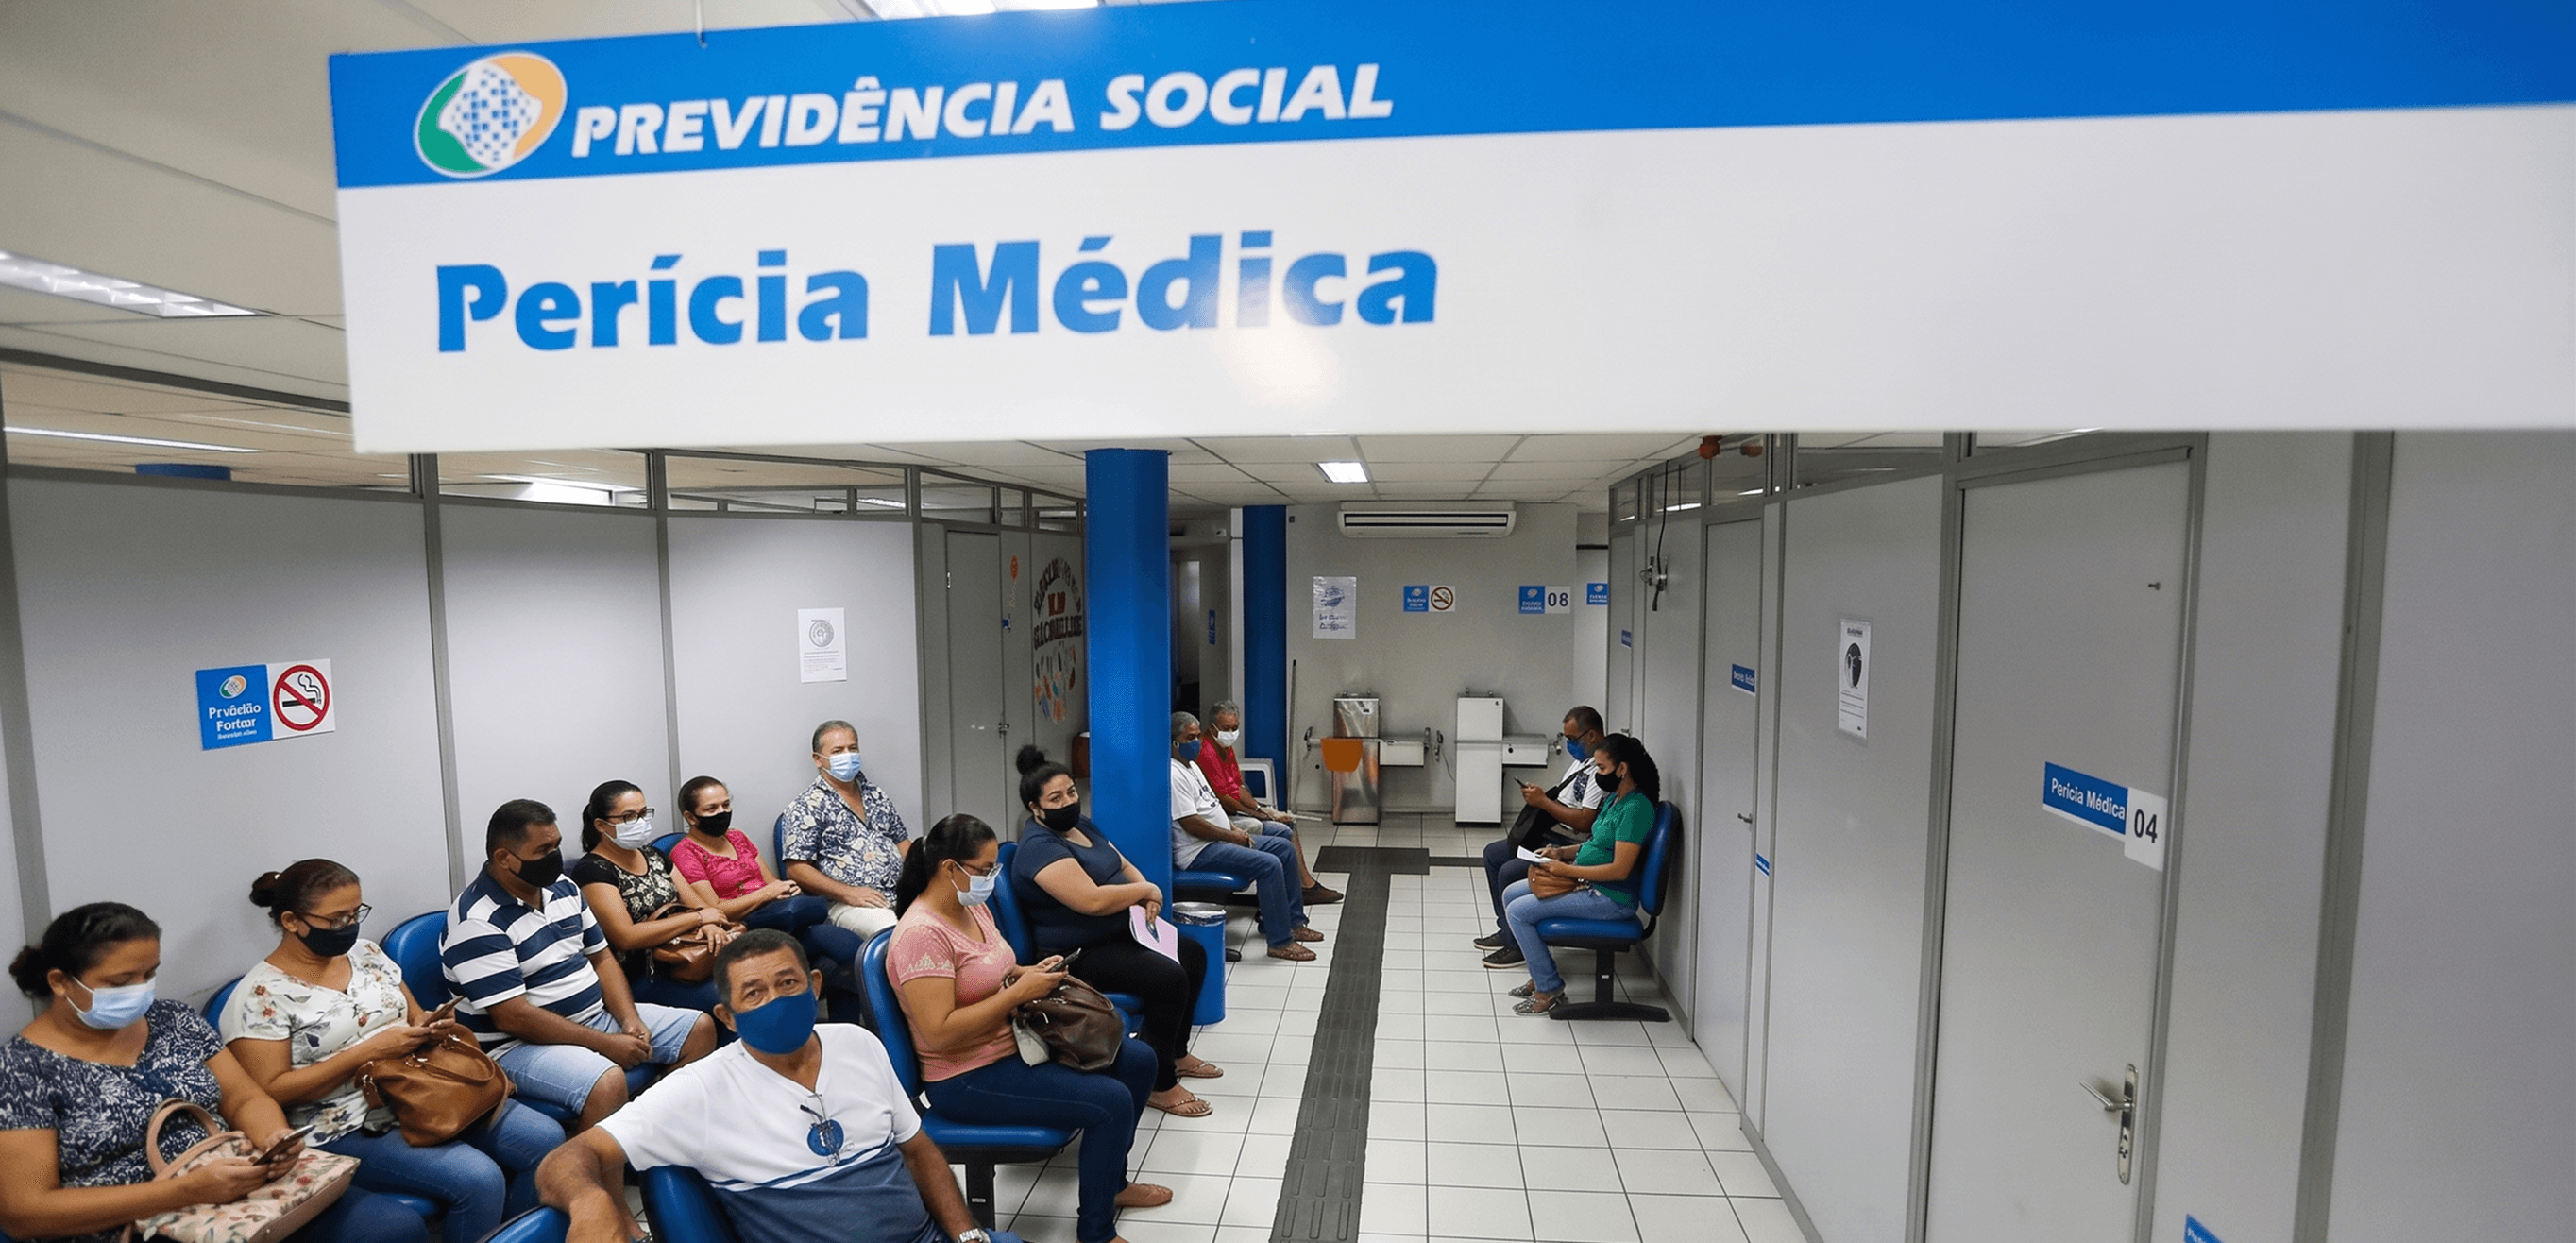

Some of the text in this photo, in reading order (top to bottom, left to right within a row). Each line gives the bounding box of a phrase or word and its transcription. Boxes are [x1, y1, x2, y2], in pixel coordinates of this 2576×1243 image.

[571, 63, 1393, 158] PREVIDÊNCIA SOCIAL
[435, 229, 1439, 354] Perícia Médica
[1547, 592, 1568, 607] 08
[2086, 790, 2126, 820] Médica
[2133, 809, 2158, 844] 04
